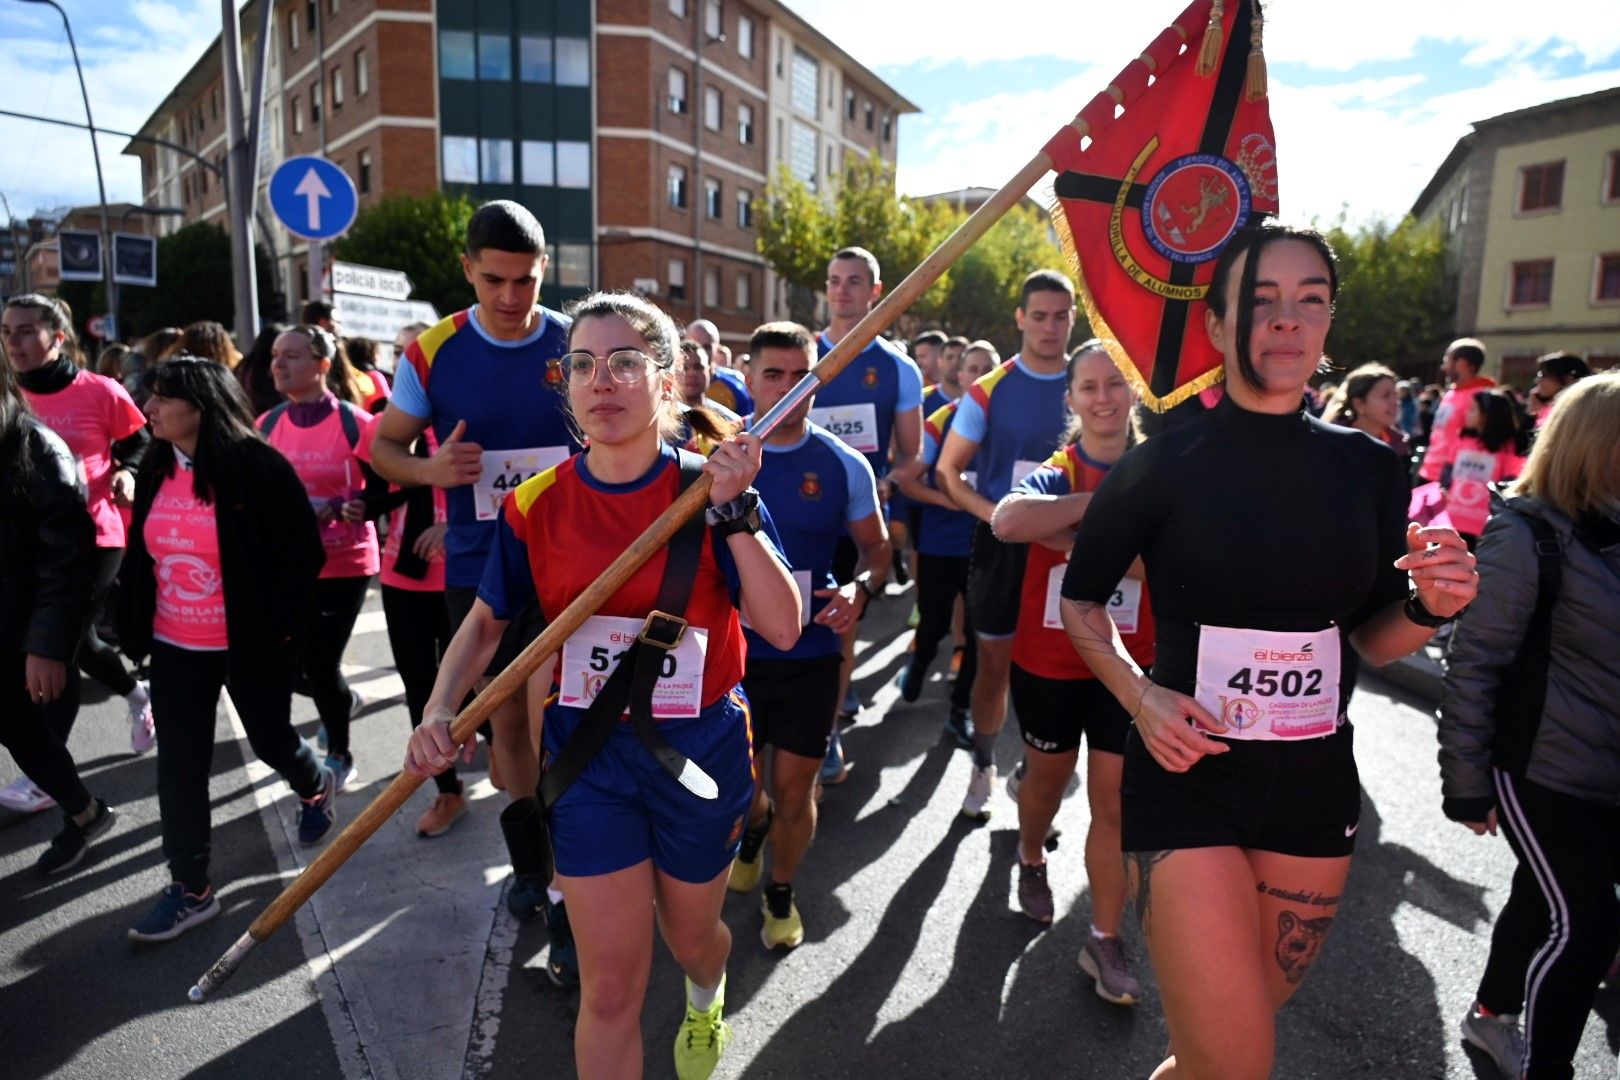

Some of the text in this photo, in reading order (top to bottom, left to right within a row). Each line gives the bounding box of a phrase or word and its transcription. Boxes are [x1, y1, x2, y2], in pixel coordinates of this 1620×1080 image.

[1126, 263, 1142, 279] DE
[1143, 277, 1202, 299] ALUMNOS
[197, 607, 211, 616] LA
[1254, 650, 1267, 661] el
[1227, 667, 1323, 697] 4502
